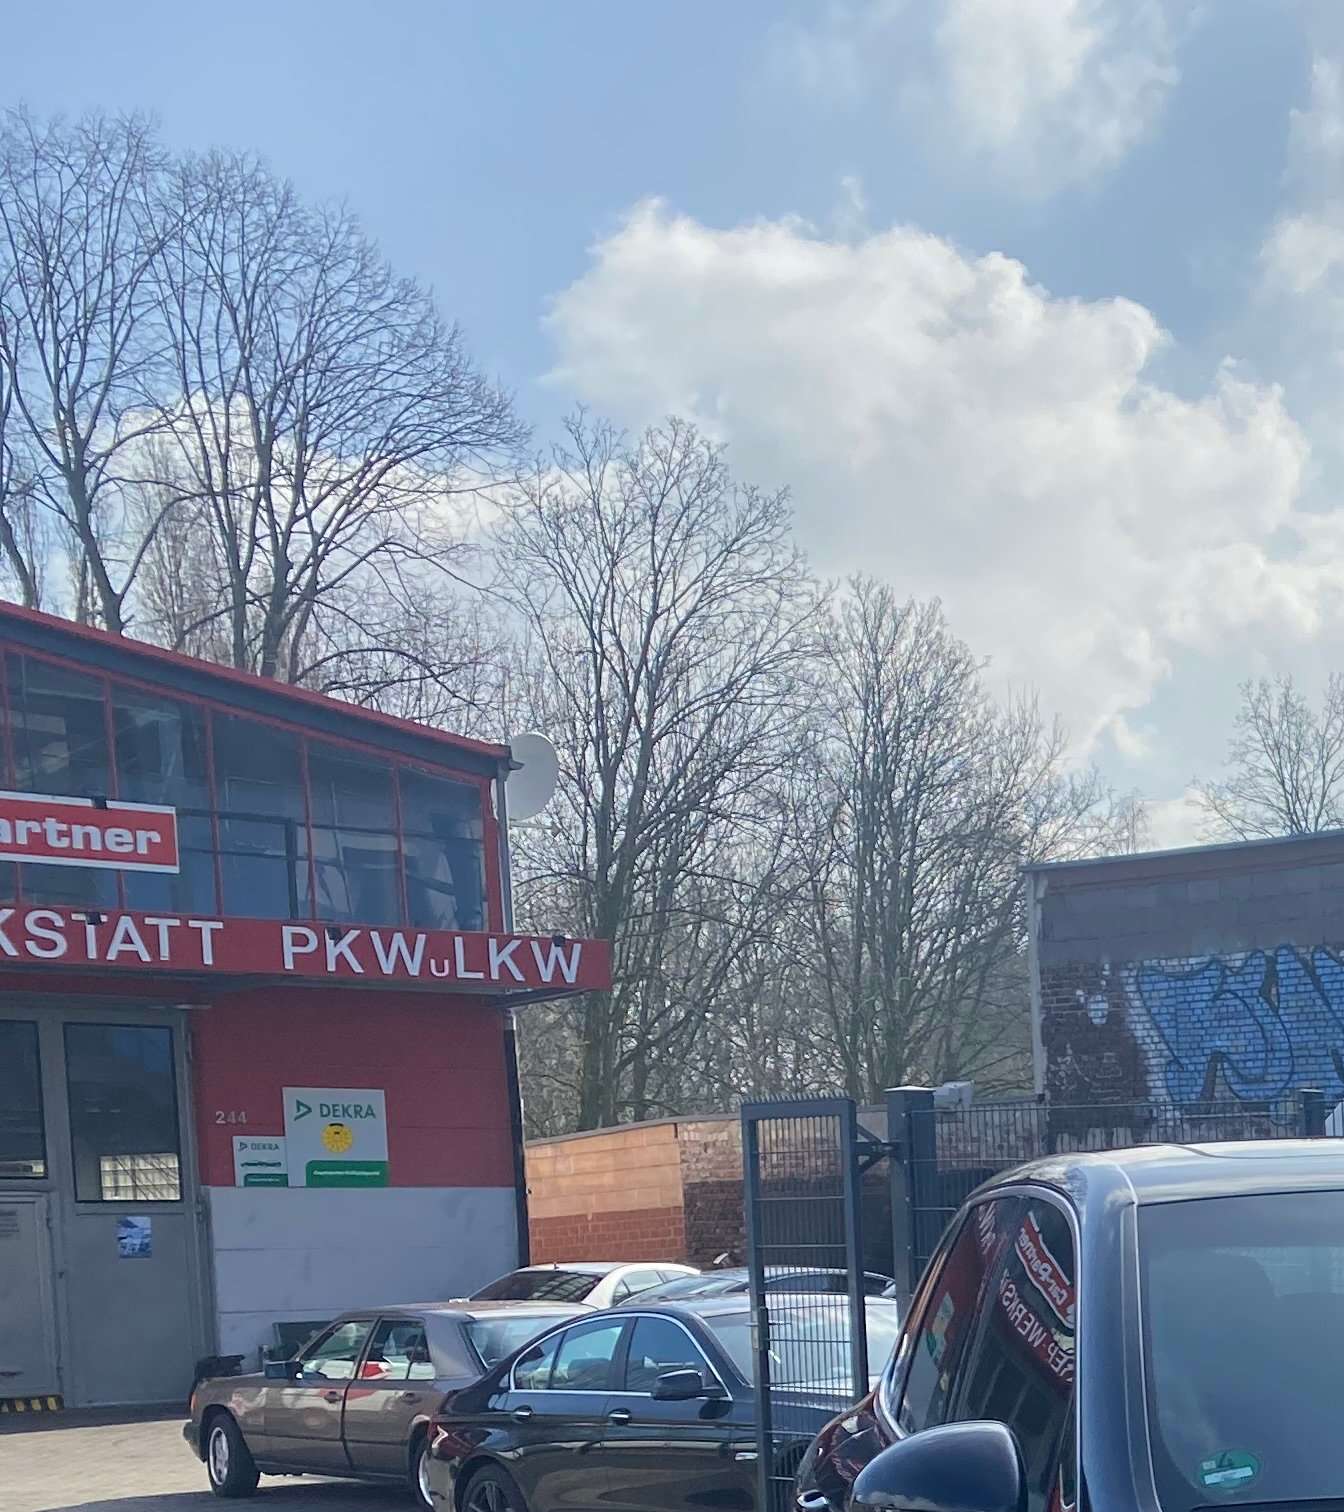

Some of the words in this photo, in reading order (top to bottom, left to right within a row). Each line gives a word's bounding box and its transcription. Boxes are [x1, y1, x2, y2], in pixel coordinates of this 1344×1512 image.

[215, 1111, 247, 1124] 244
[319, 1103, 376, 1119] DEKRA
[251, 1142, 279, 1151] DEKRA
